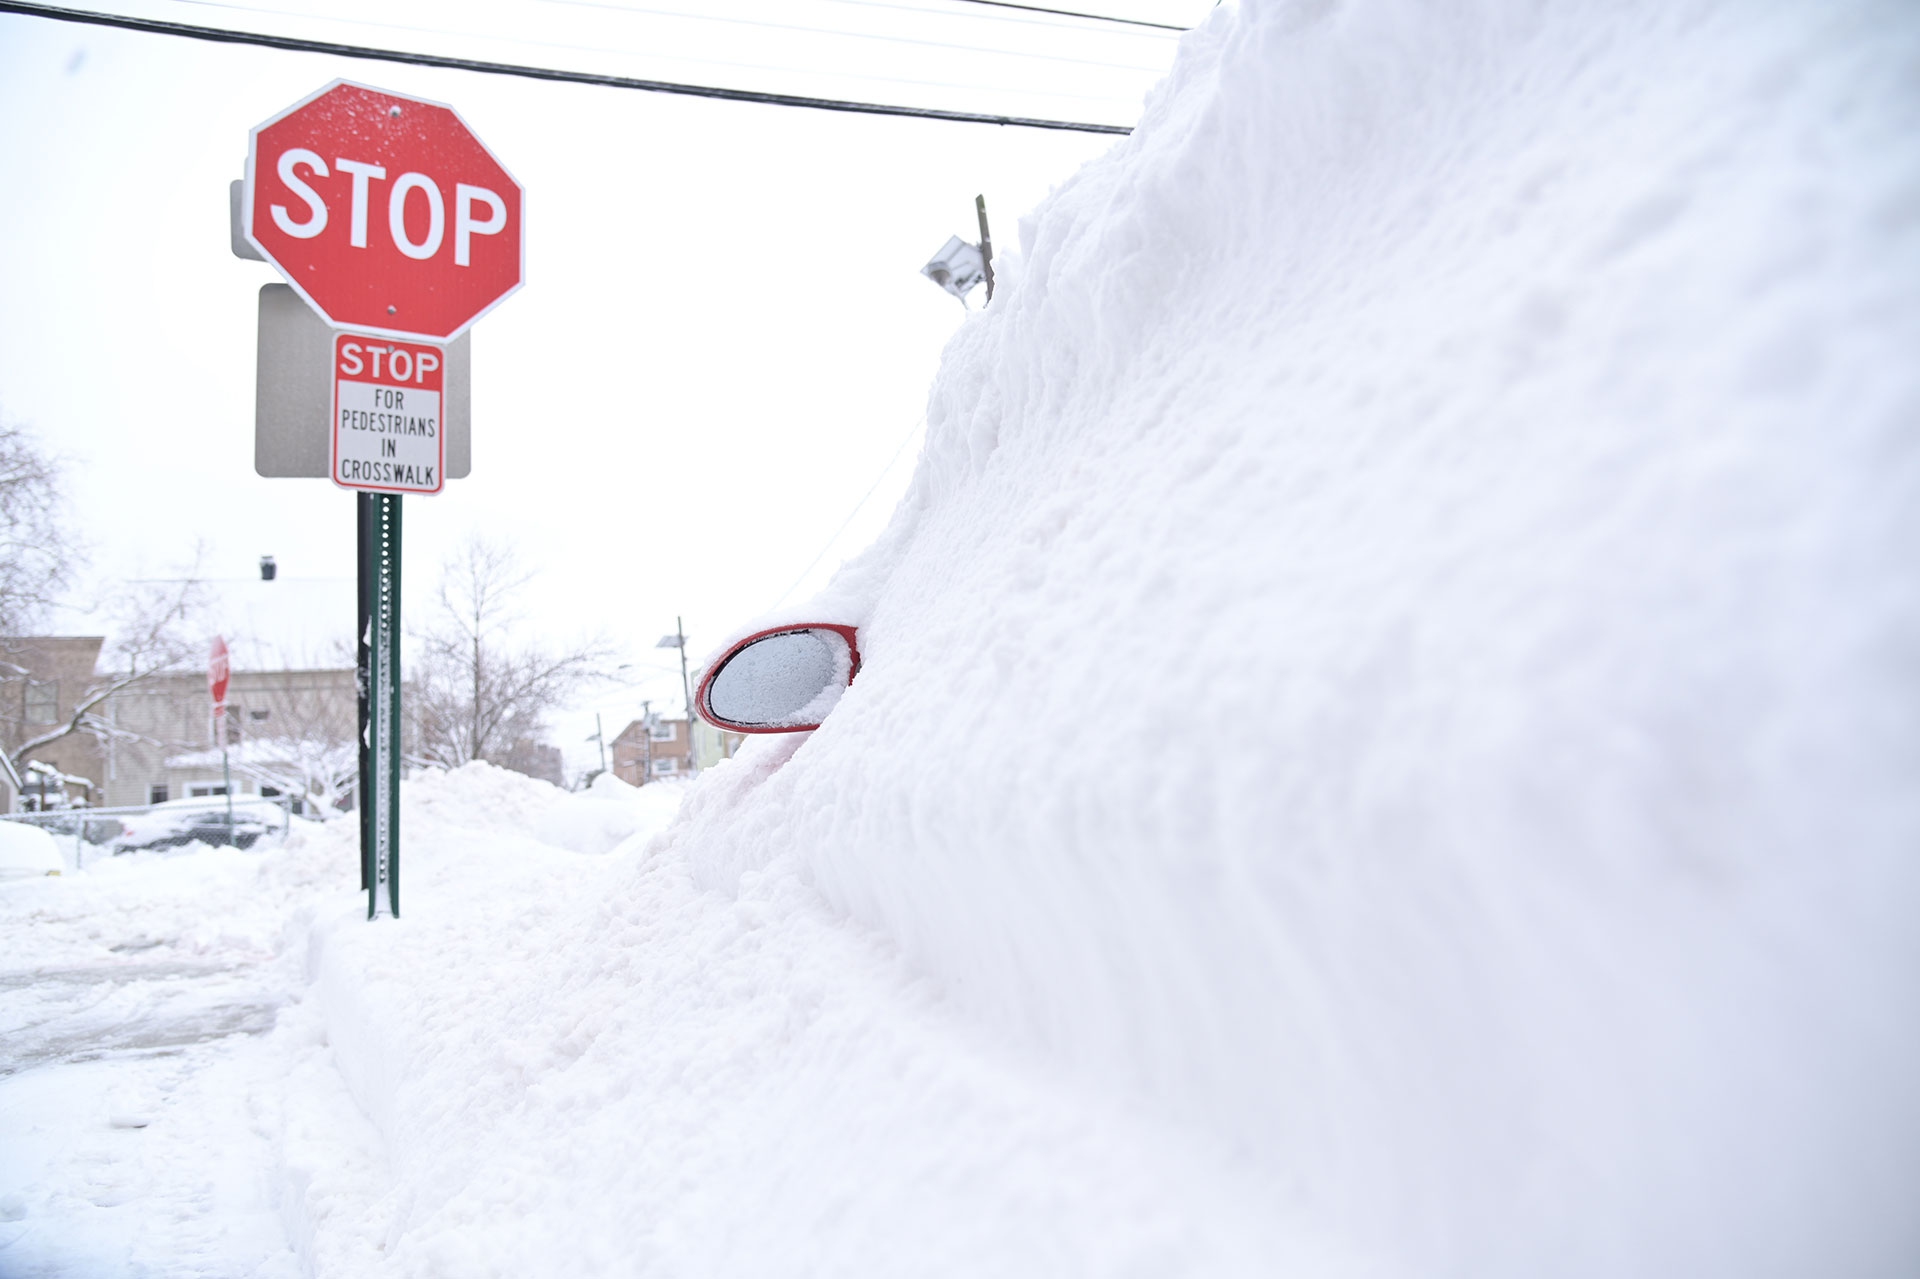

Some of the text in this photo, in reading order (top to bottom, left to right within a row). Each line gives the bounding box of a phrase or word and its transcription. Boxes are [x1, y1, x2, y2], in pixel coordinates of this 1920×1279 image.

[270, 148, 507, 267] STOP
[340, 343, 439, 383] STOP
[375, 389, 404, 410] FOR
[342, 409, 435, 437] PEDESTRIANS
[382, 438, 396, 457] IN
[342, 459, 433, 485] CROSSWALK
